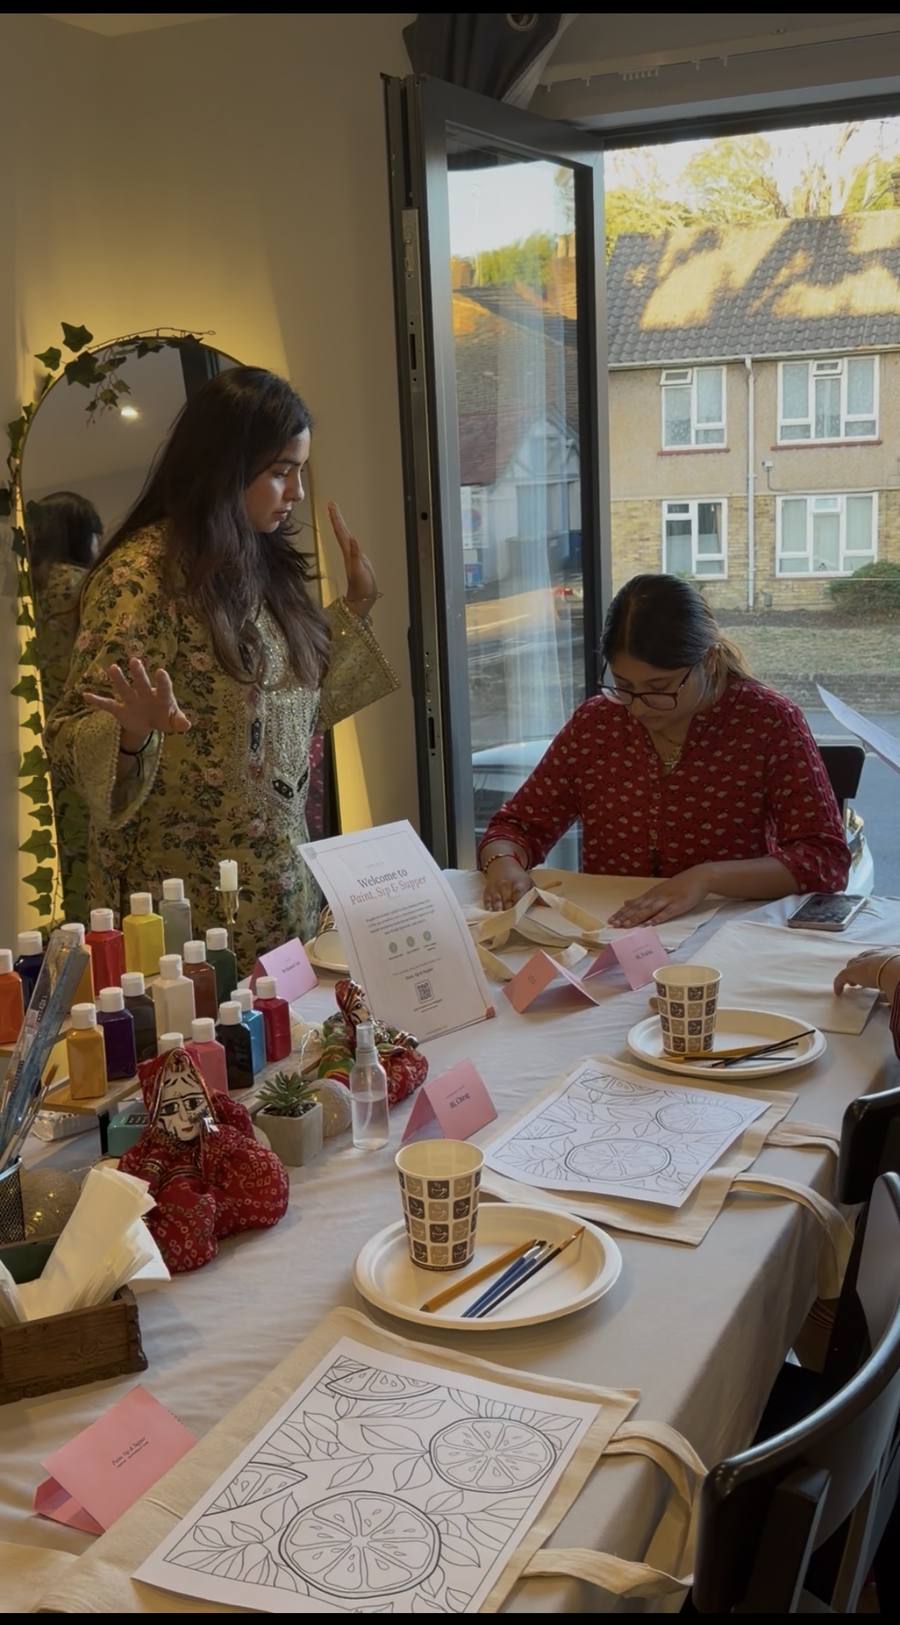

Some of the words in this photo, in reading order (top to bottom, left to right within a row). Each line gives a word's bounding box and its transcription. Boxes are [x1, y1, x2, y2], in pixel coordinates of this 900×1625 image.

[357, 871, 397, 888] Welcome
[397, 868, 408, 878] to
[375, 885, 391, 898] Sip
[398, 876, 426, 891] Supper
